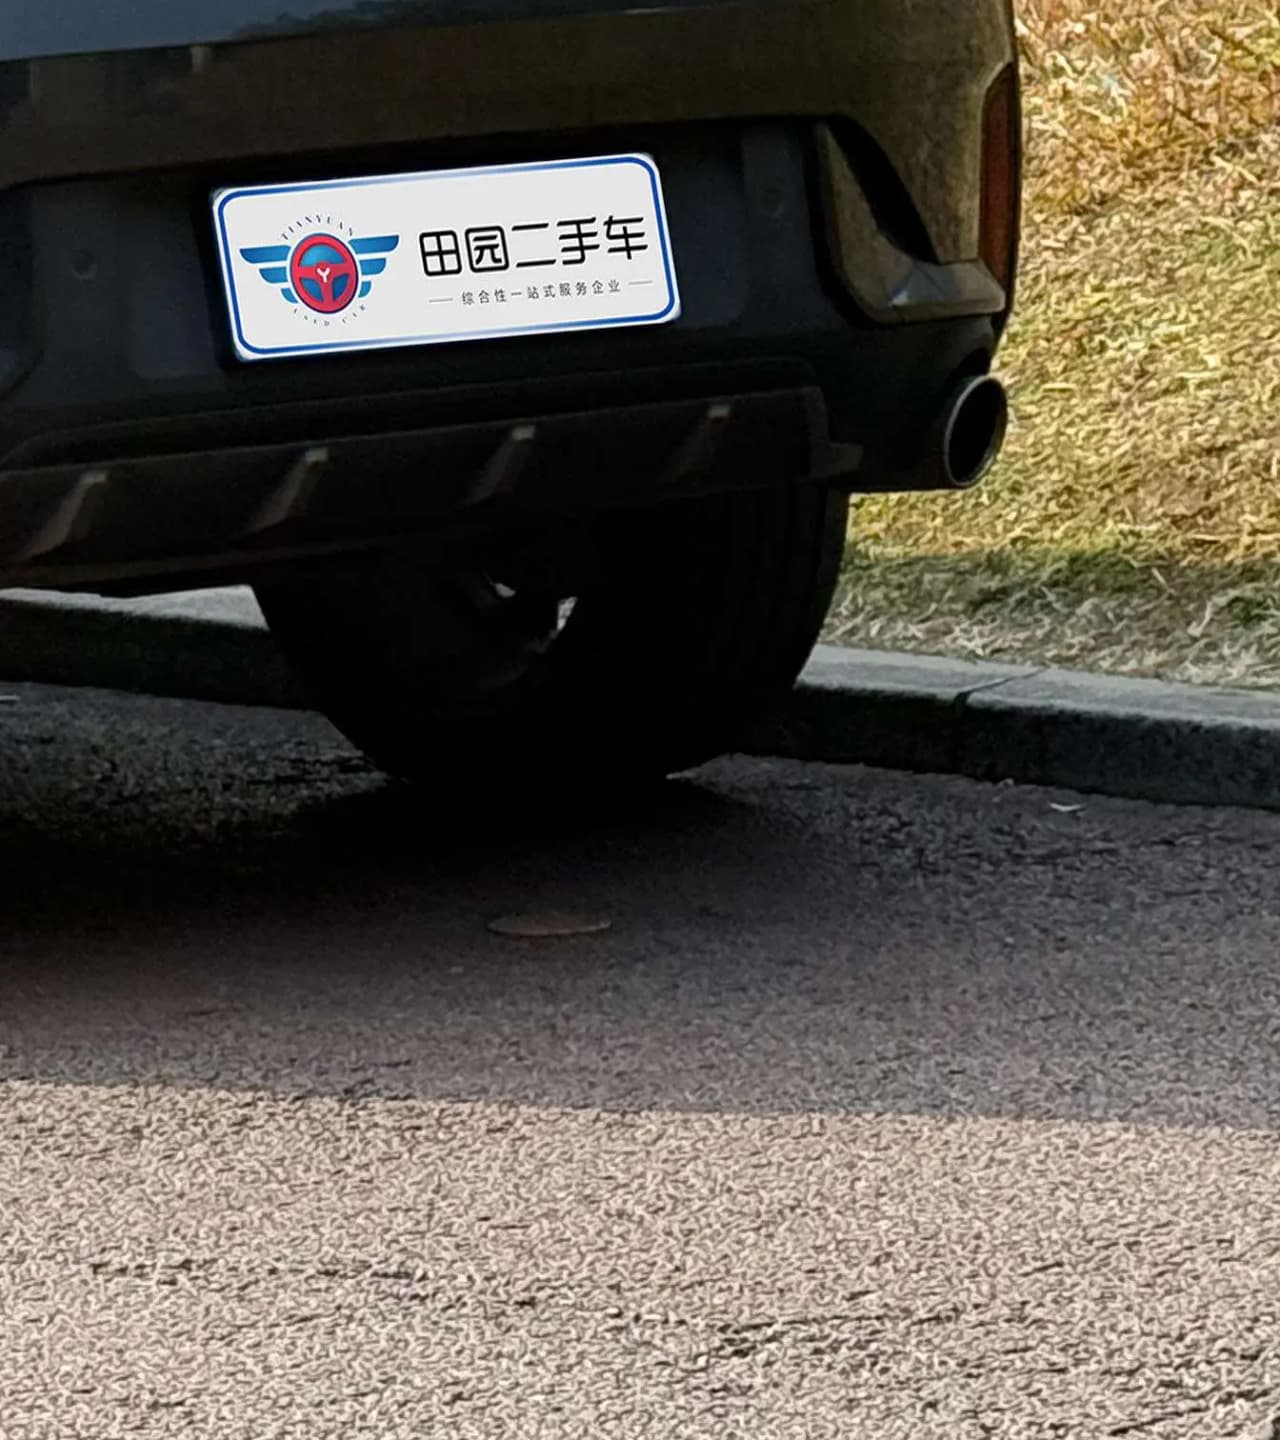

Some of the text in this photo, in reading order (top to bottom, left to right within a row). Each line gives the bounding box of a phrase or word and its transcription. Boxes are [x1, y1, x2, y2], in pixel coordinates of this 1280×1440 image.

[418, 215, 649, 277] 田园二手车
[460, 278, 622, 307] 综合性一站式服务企业
